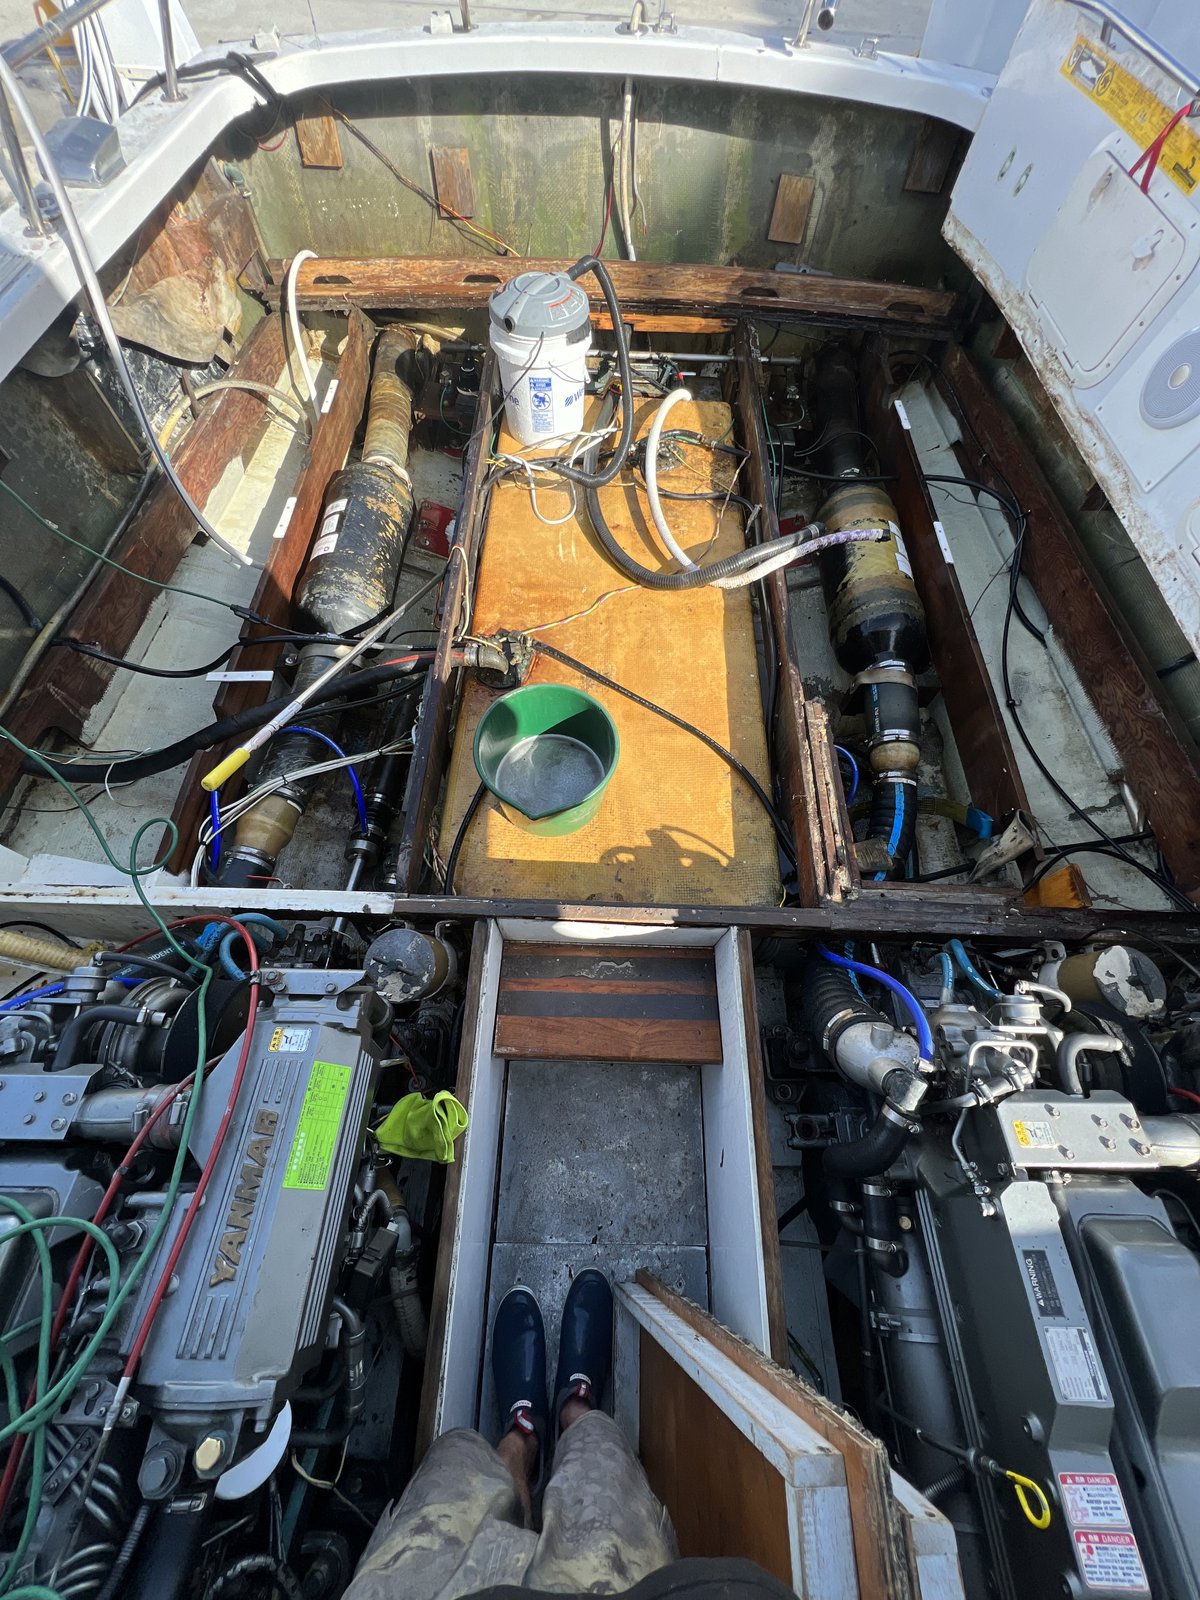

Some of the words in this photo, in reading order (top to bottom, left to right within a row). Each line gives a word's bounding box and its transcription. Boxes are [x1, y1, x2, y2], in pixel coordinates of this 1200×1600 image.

[209, 1108, 279, 1288] YANMAR
[1025, 1258, 1043, 1299] WARNING
[1086, 1476, 1112, 1484] DANGER
[1101, 1534, 1131, 1544] DANGER
